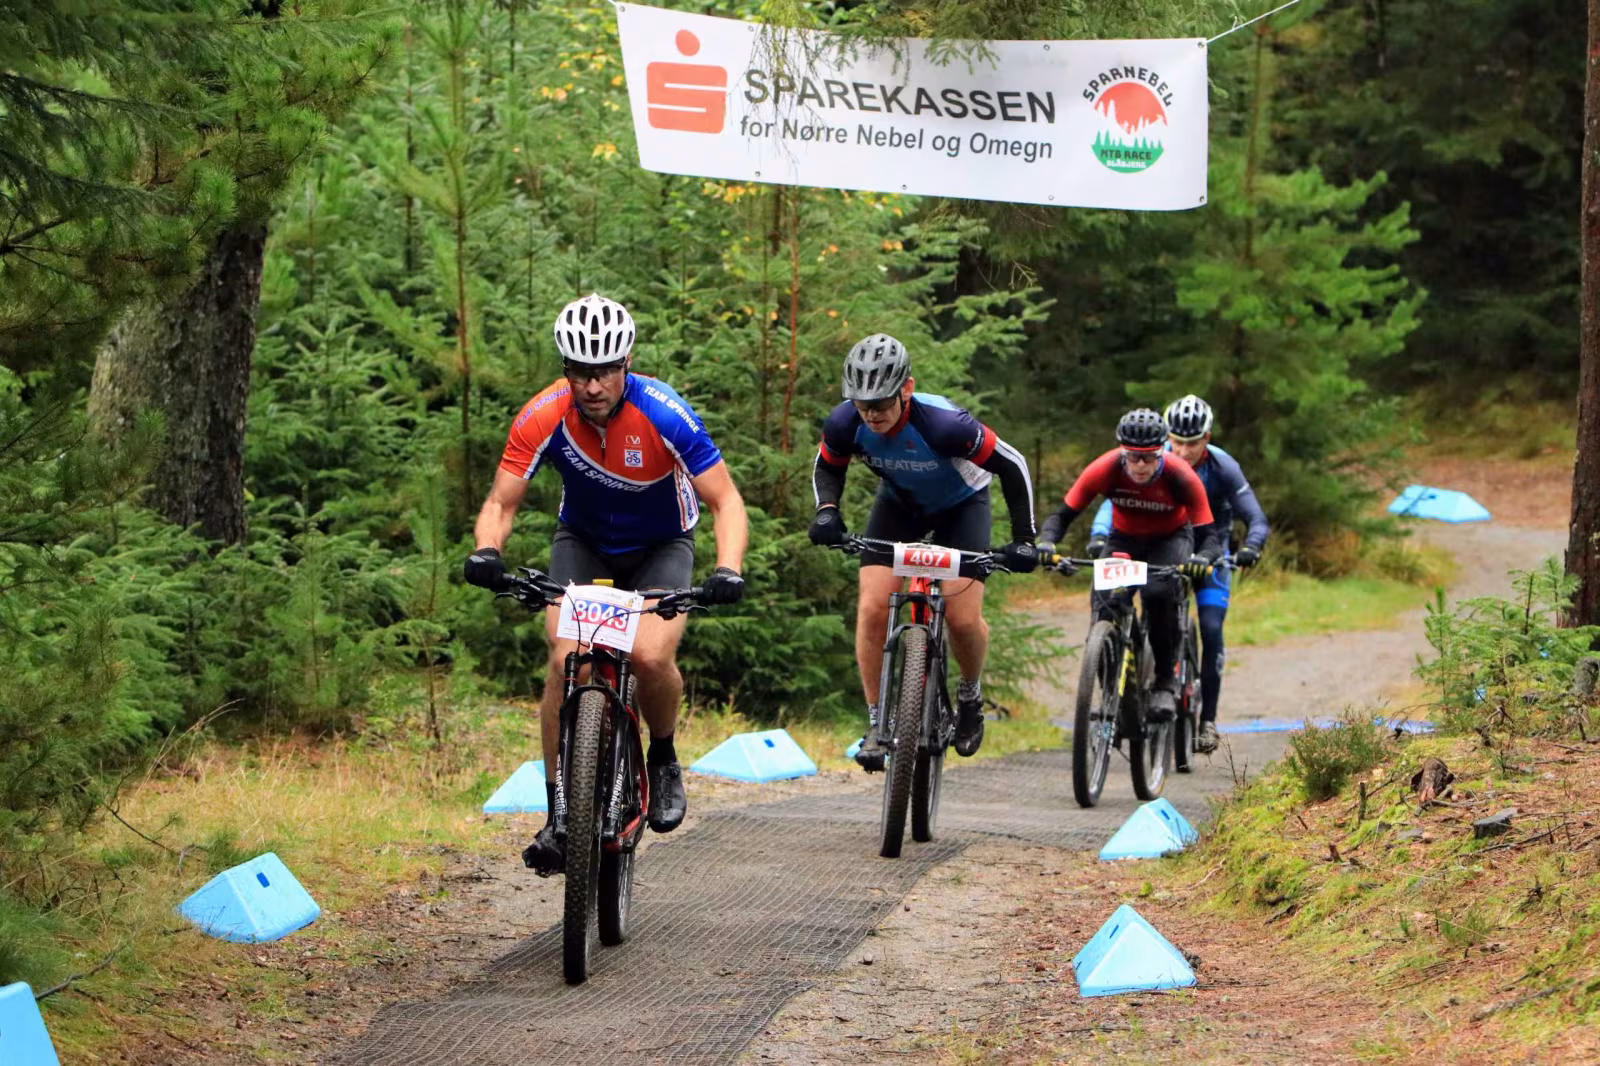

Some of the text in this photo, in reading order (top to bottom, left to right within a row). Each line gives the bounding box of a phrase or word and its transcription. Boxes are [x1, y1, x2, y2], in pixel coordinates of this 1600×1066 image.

[744, 68, 1056, 124] SPAREKASSEN
[1082, 66, 1173, 107] SPARNEBEL
[740, 115, 1053, 163] for Nørre Nebel og Omegn
[1101, 149, 1152, 161] MTB RACE
[644, 385, 700, 434] TEAM SPRINGE
[561, 444, 650, 493] TEAM SPRINGE
[885, 459, 939, 472] EATERS
[910, 550, 944, 567] 407
[573, 600, 628, 629] 8043
